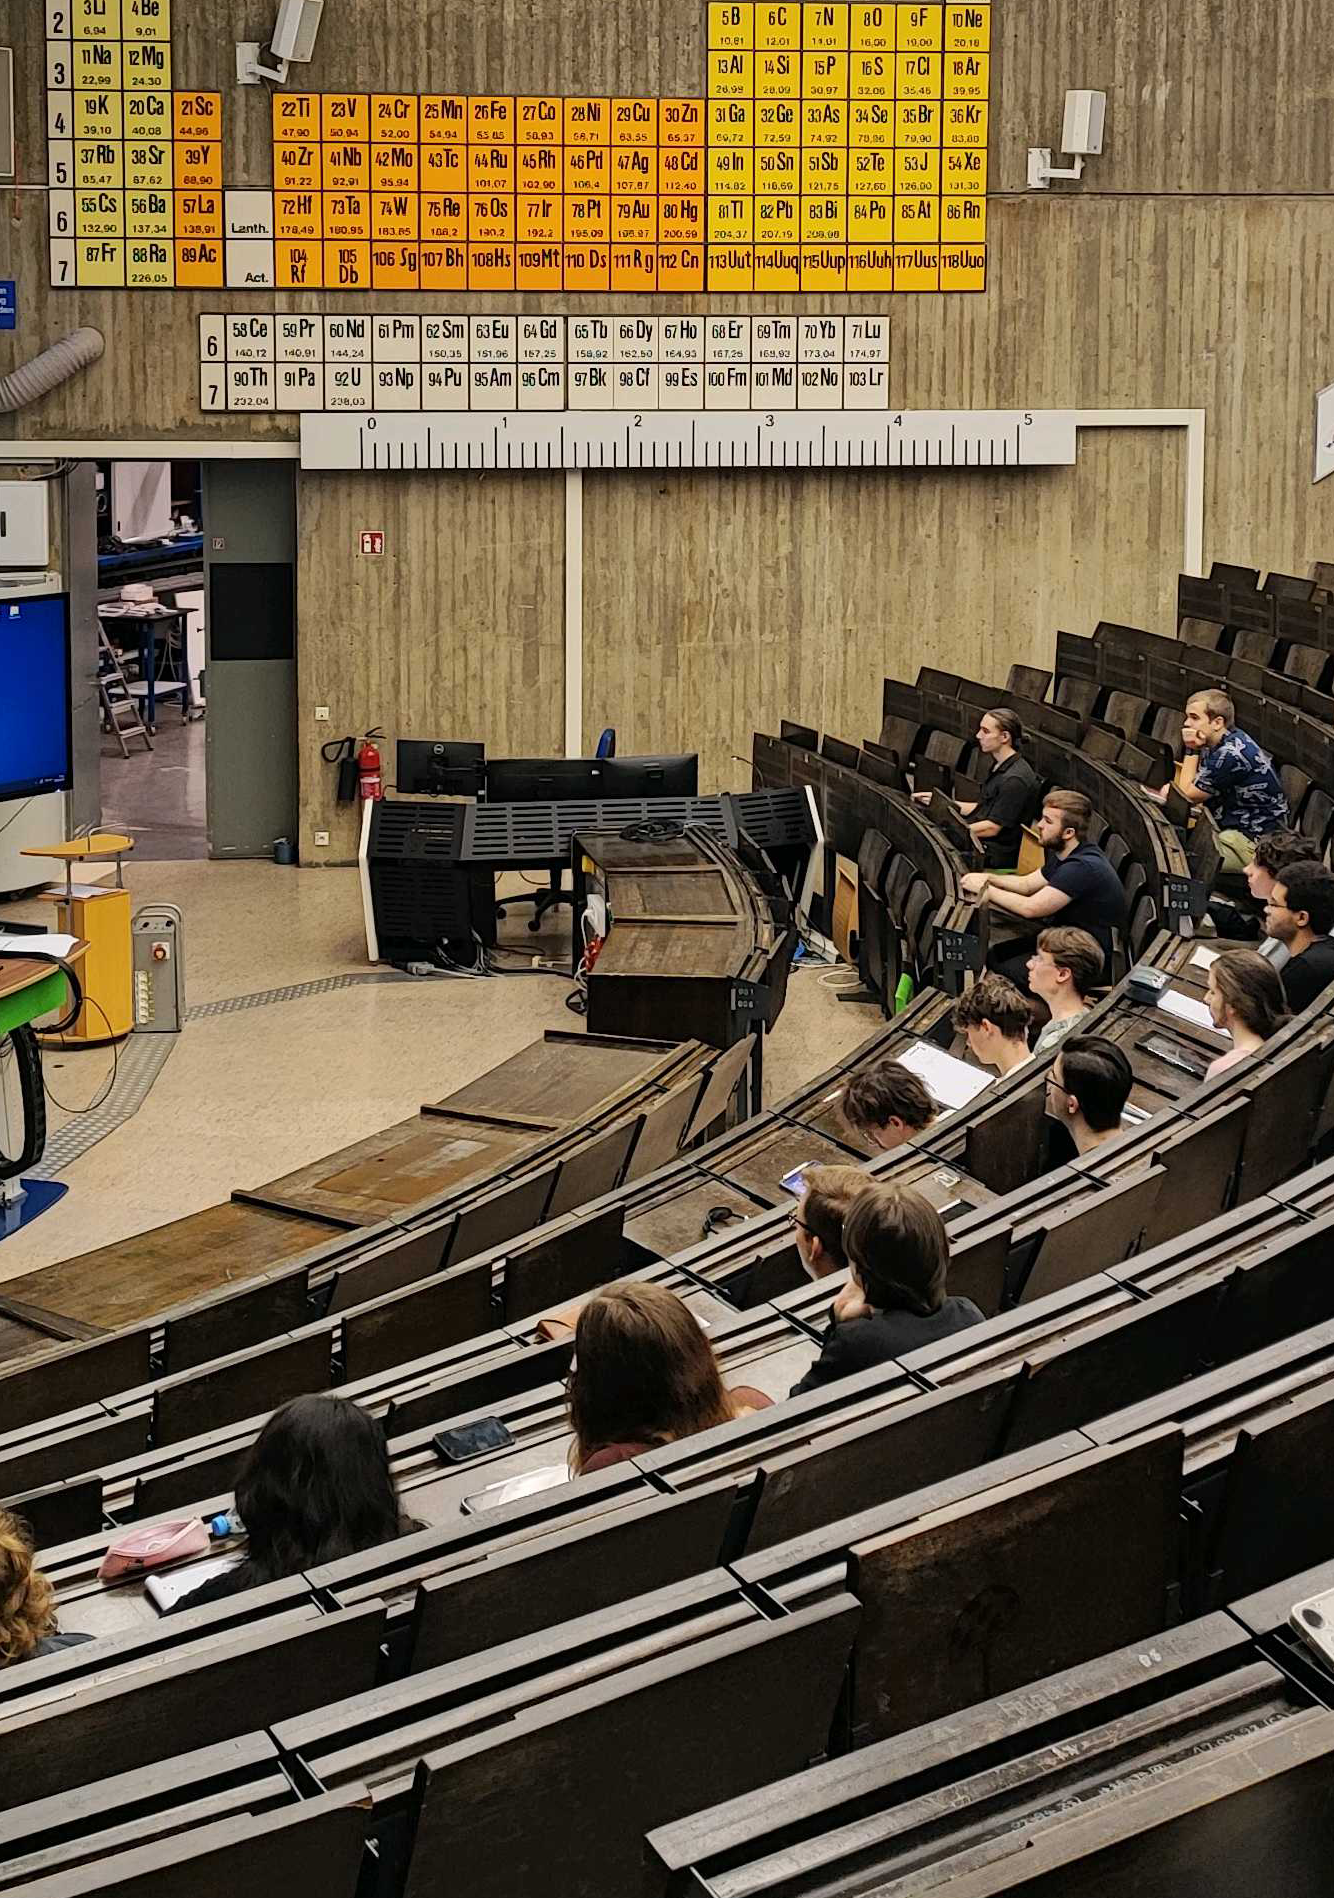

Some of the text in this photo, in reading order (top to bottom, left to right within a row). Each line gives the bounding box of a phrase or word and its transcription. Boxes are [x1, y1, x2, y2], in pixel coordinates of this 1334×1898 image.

[53, 11, 64, 34] 2
[54, 62, 65, 85] 3
[54, 112, 66, 134] 4
[56, 162, 67, 184] 5
[56, 211, 68, 233] 6
[231, 222, 269, 234] Lanth.
[291, 249, 306, 263] 104
[339, 249, 356, 263] 105
[58, 260, 68, 282] 7
[244, 272, 269, 283] Act.
[291, 265, 306, 283] Rf
[339, 265, 358, 283] Db
[207, 335, 218, 357] 6
[208, 384, 218, 405] 7
[367, 417, 377, 430] 0
[502, 416, 507, 429] 1
[634, 414, 642, 427] 2
[765, 414, 775, 427] 3
[893, 414, 902, 427] 4
[1024, 413, 1033, 426] 5
